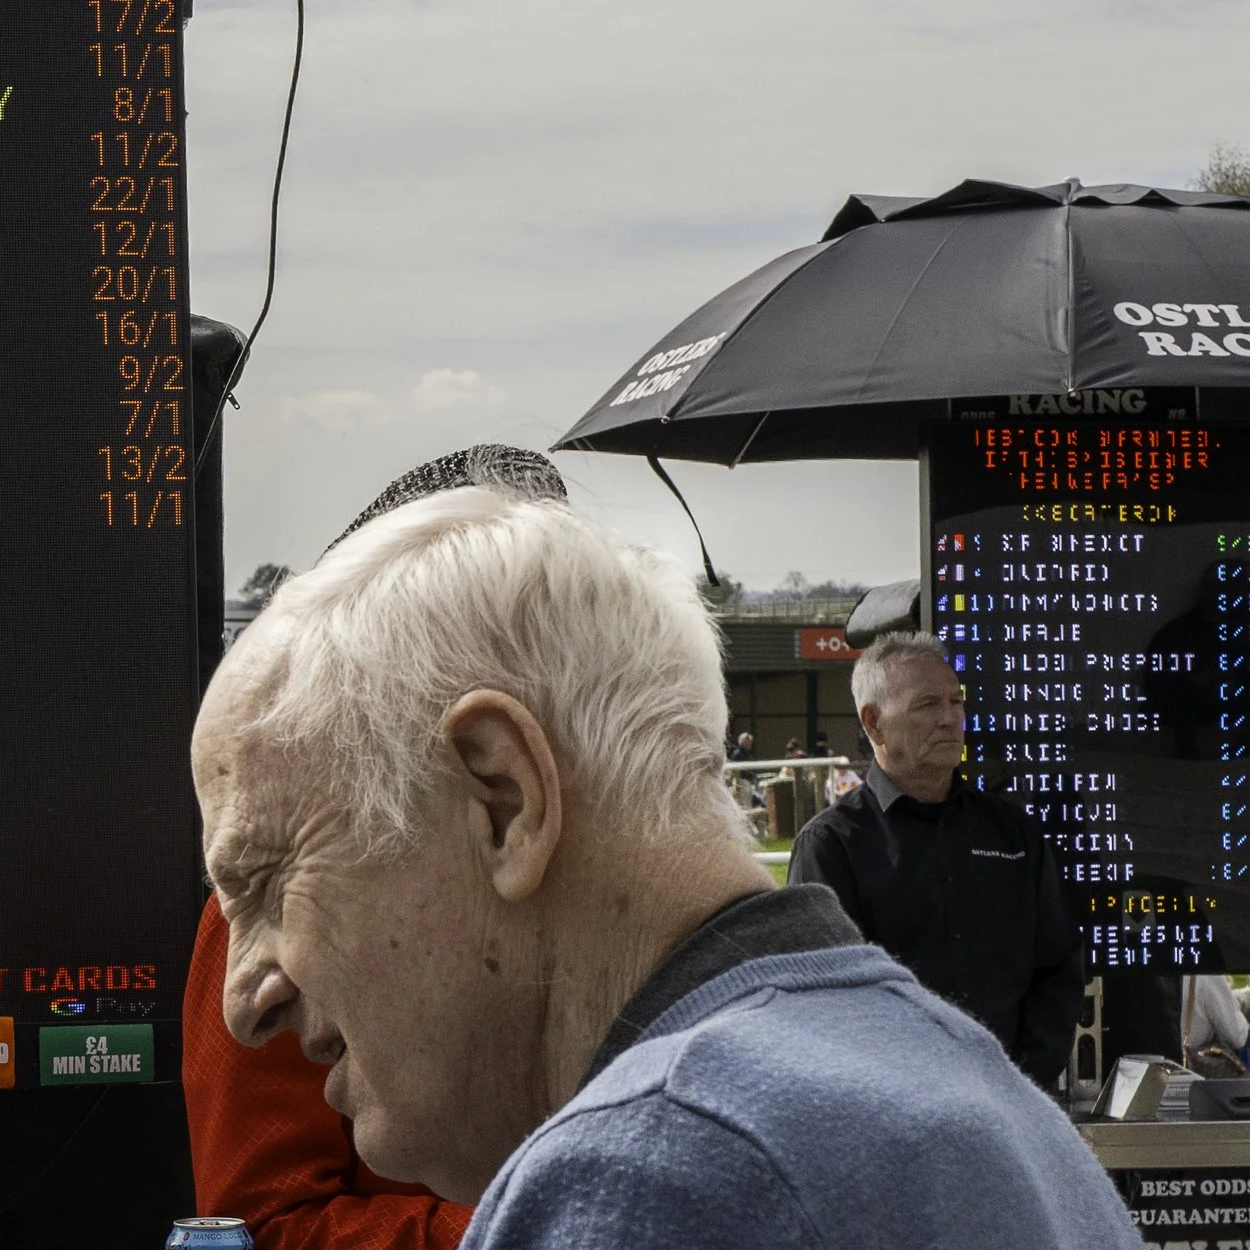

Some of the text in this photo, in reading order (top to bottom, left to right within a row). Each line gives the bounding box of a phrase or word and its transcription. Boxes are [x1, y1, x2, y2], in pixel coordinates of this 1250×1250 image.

[89, 0, 174, 35] 17/2
[90, 43, 170, 79] 11/1
[114, 88, 171, 124] 8/1
[92, 132, 178, 168] 11/2
[90, 177, 173, 213] 22/1
[94, 222, 174, 258] 12/1
[95, 267, 175, 302] 20/1
[96, 311, 176, 347] 16/1
[120, 356, 183, 392] 9/2
[120, 401, 178, 437] 7/1
[1008, 389, 1147, 415] RACING
[99, 446, 185, 482] 13/2
[101, 491, 181, 527] 11/1
[25, 965, 157, 991] CARDS
[86, 1036, 108, 1055] £4
[53, 1054, 141, 1075] MIN STAKE
[1140, 1180, 1196, 1197] BEST
[1129, 1208, 1250, 1226] GUARANTE
[193, 1233, 222, 1241] MANGO
